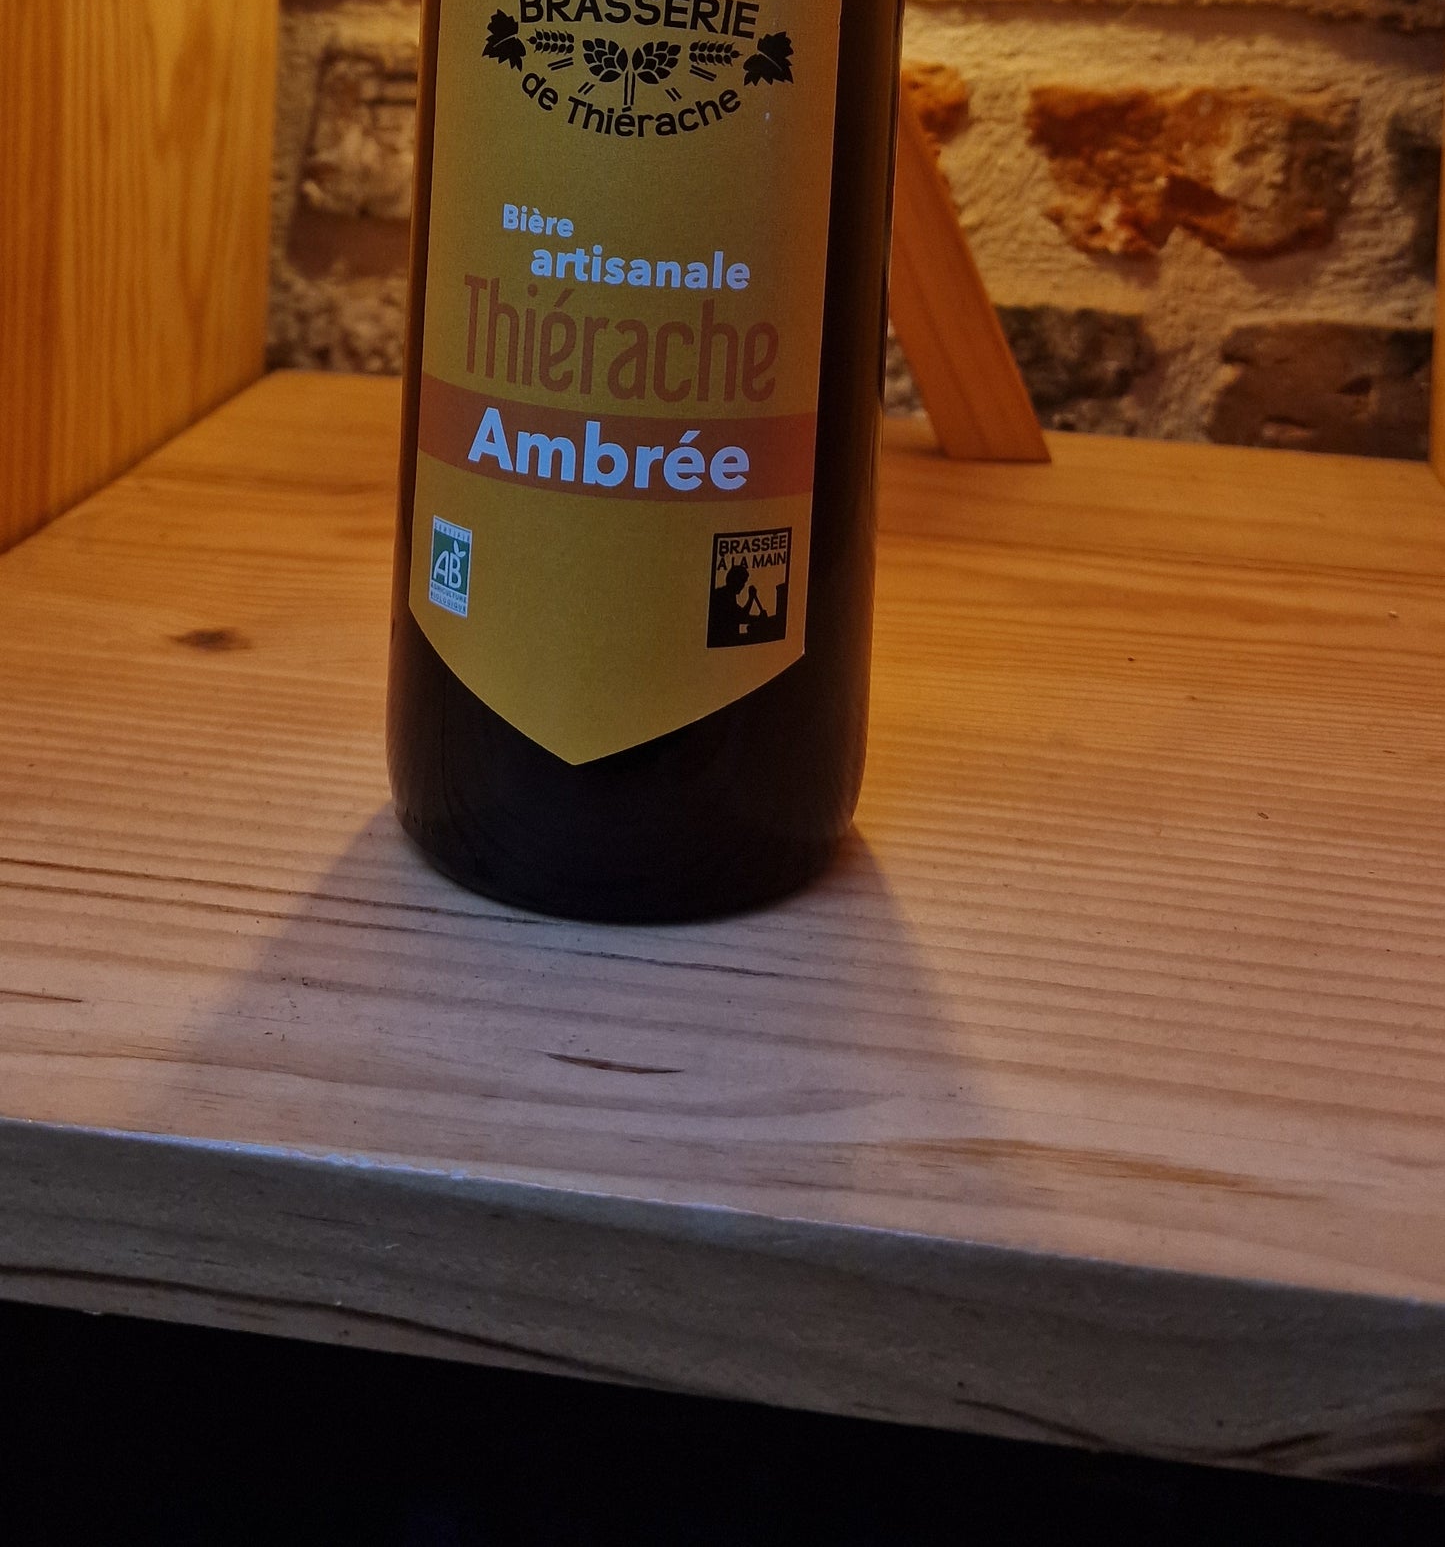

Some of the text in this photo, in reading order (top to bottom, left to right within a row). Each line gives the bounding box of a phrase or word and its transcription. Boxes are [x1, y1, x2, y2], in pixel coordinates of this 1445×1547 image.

[521, 72, 741, 137] de Thiérache
[502, 203, 575, 238] Bière
[530, 244, 751, 290] artisanale
[464, 274, 780, 402] Thiérache
[467, 407, 750, 490] Ambrée
[433, 550, 462, 588] AB
[752, 551, 786, 568] MAIN
